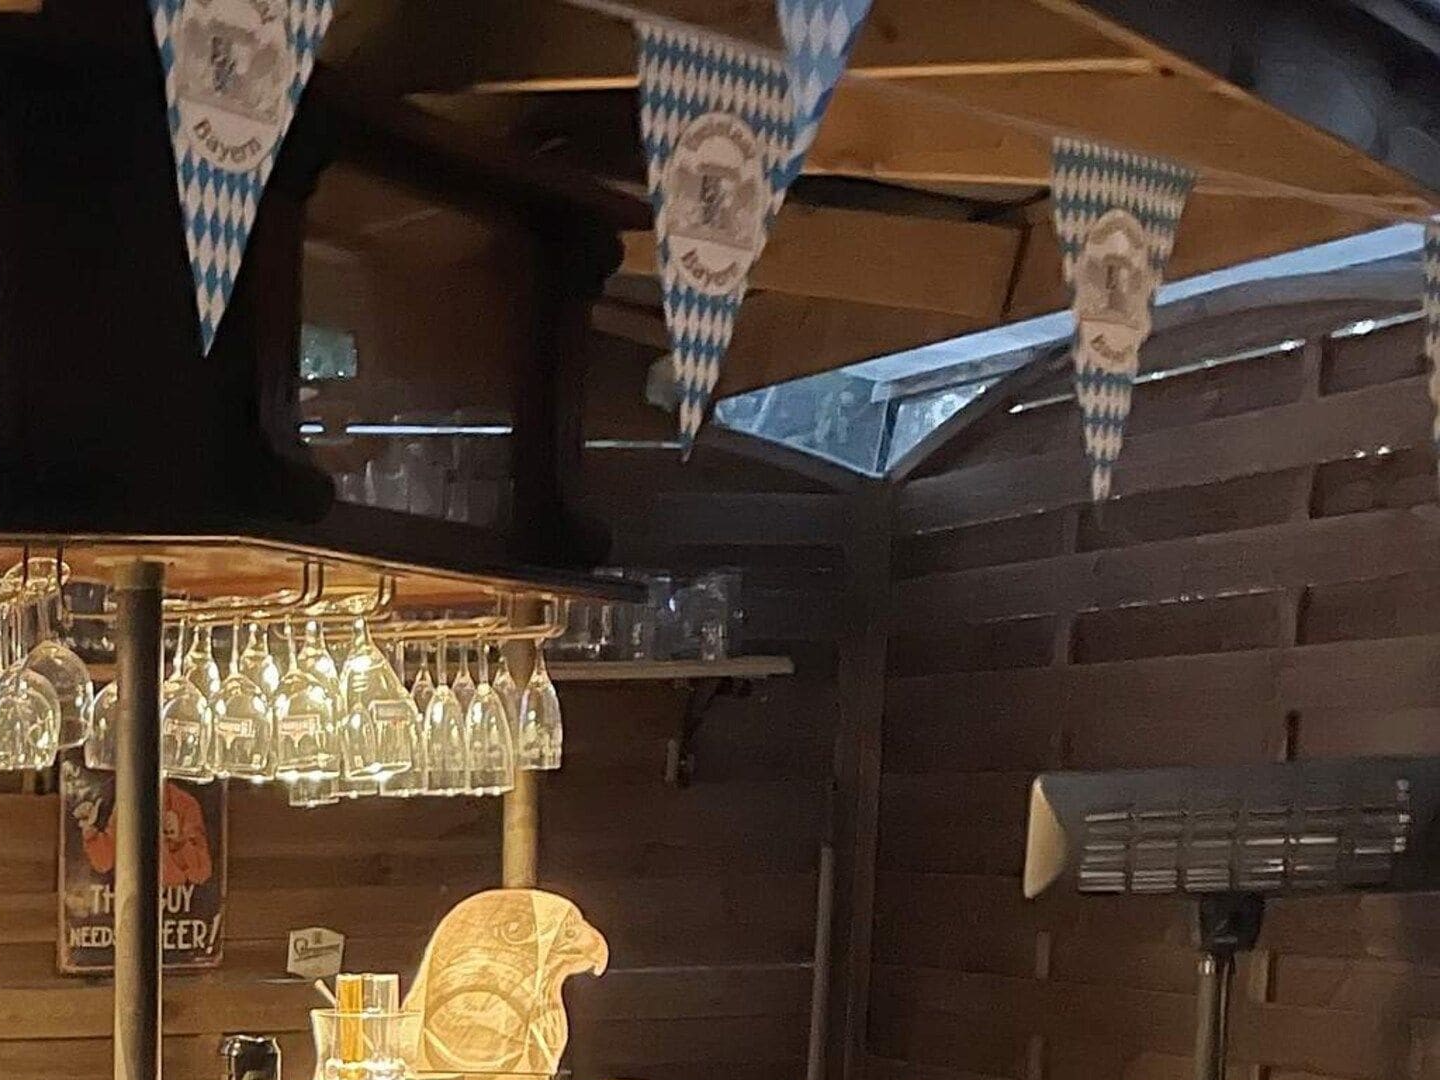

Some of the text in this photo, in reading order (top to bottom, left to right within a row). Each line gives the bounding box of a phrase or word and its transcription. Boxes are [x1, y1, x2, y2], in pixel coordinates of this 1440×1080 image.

[192, 118, 261, 163] Bayern
[69, 911, 223, 955] NEED EER!
